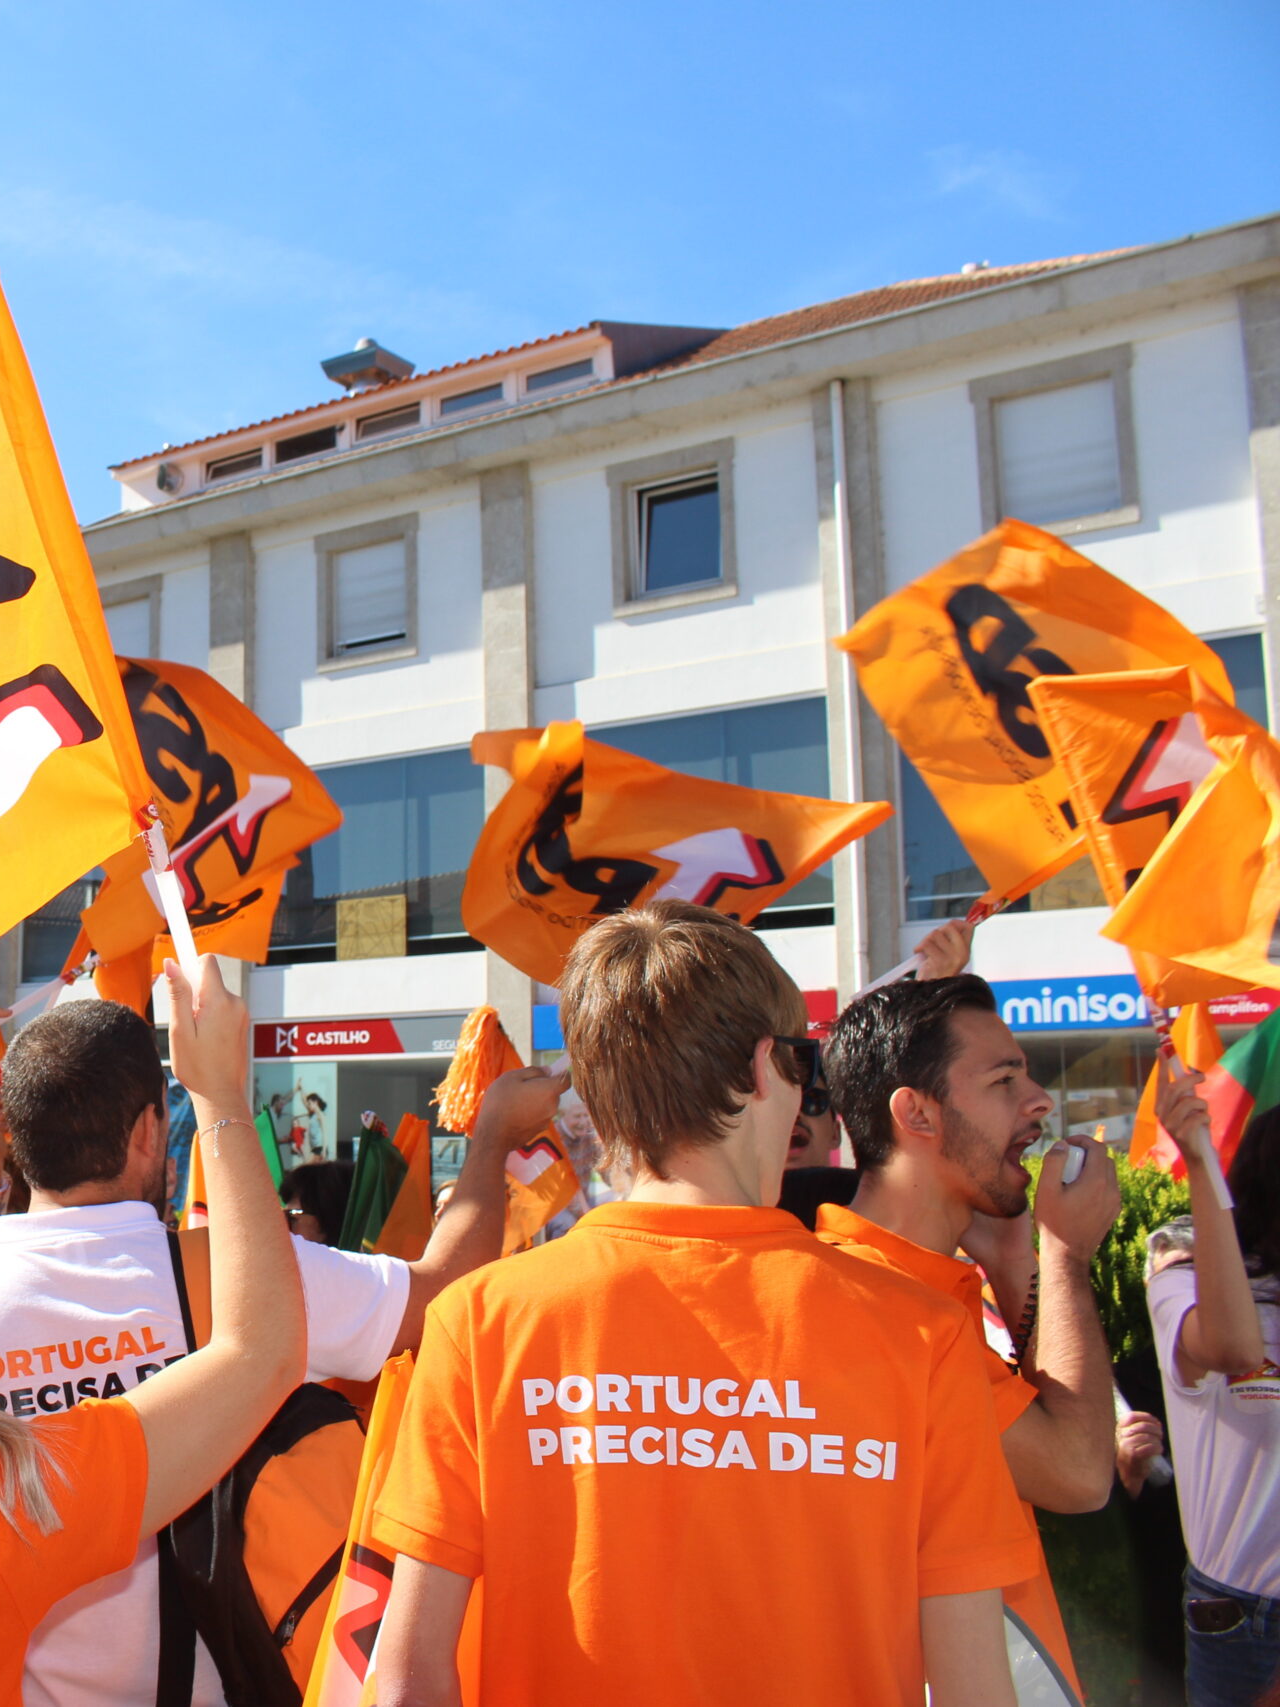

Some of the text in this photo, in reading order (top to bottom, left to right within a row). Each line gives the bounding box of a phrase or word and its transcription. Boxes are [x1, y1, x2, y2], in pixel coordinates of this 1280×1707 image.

[305, 1030, 371, 1047] CASTILHO
[522, 1374, 815, 1419] PORTUGAL
[527, 1426, 897, 1480] PRECISA DE SI
